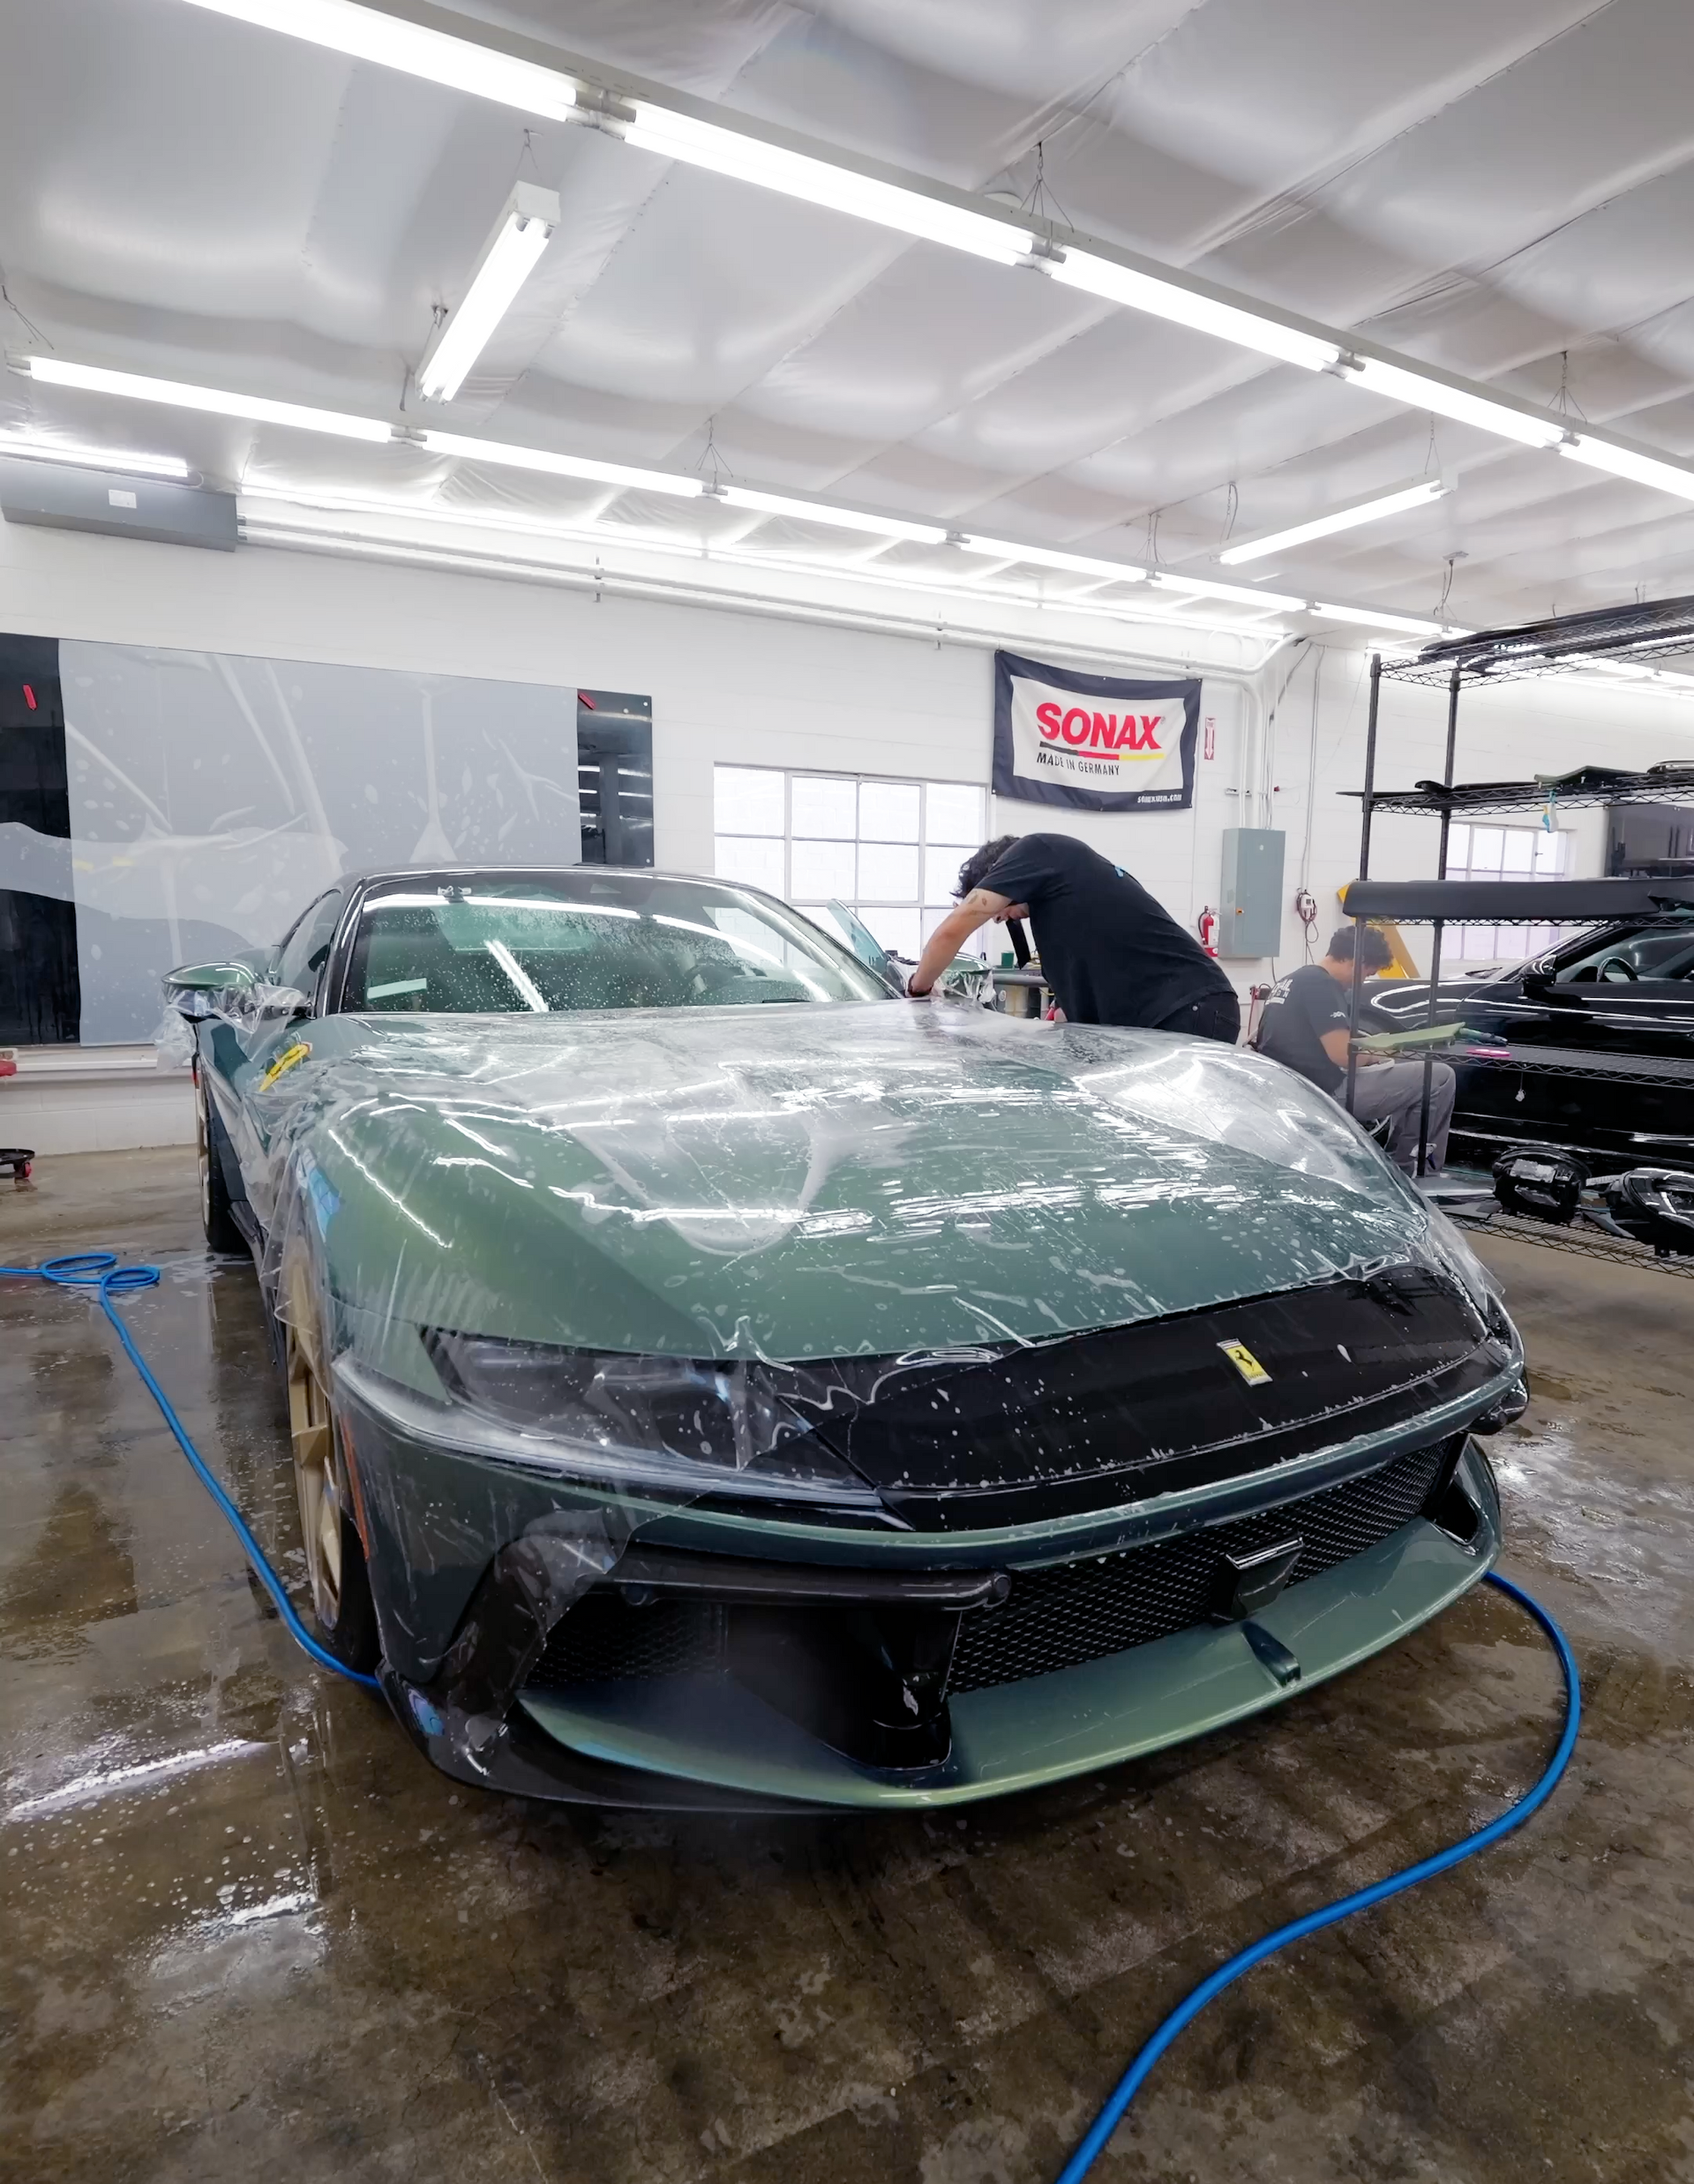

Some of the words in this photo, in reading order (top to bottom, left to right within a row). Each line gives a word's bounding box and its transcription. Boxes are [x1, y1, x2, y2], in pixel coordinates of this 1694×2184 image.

[1036, 702, 1162, 749] SONAX
[1037, 752, 1064, 766] MADE
[1066, 759, 1076, 770] IN
[1077, 761, 1120, 776] GERMANY
